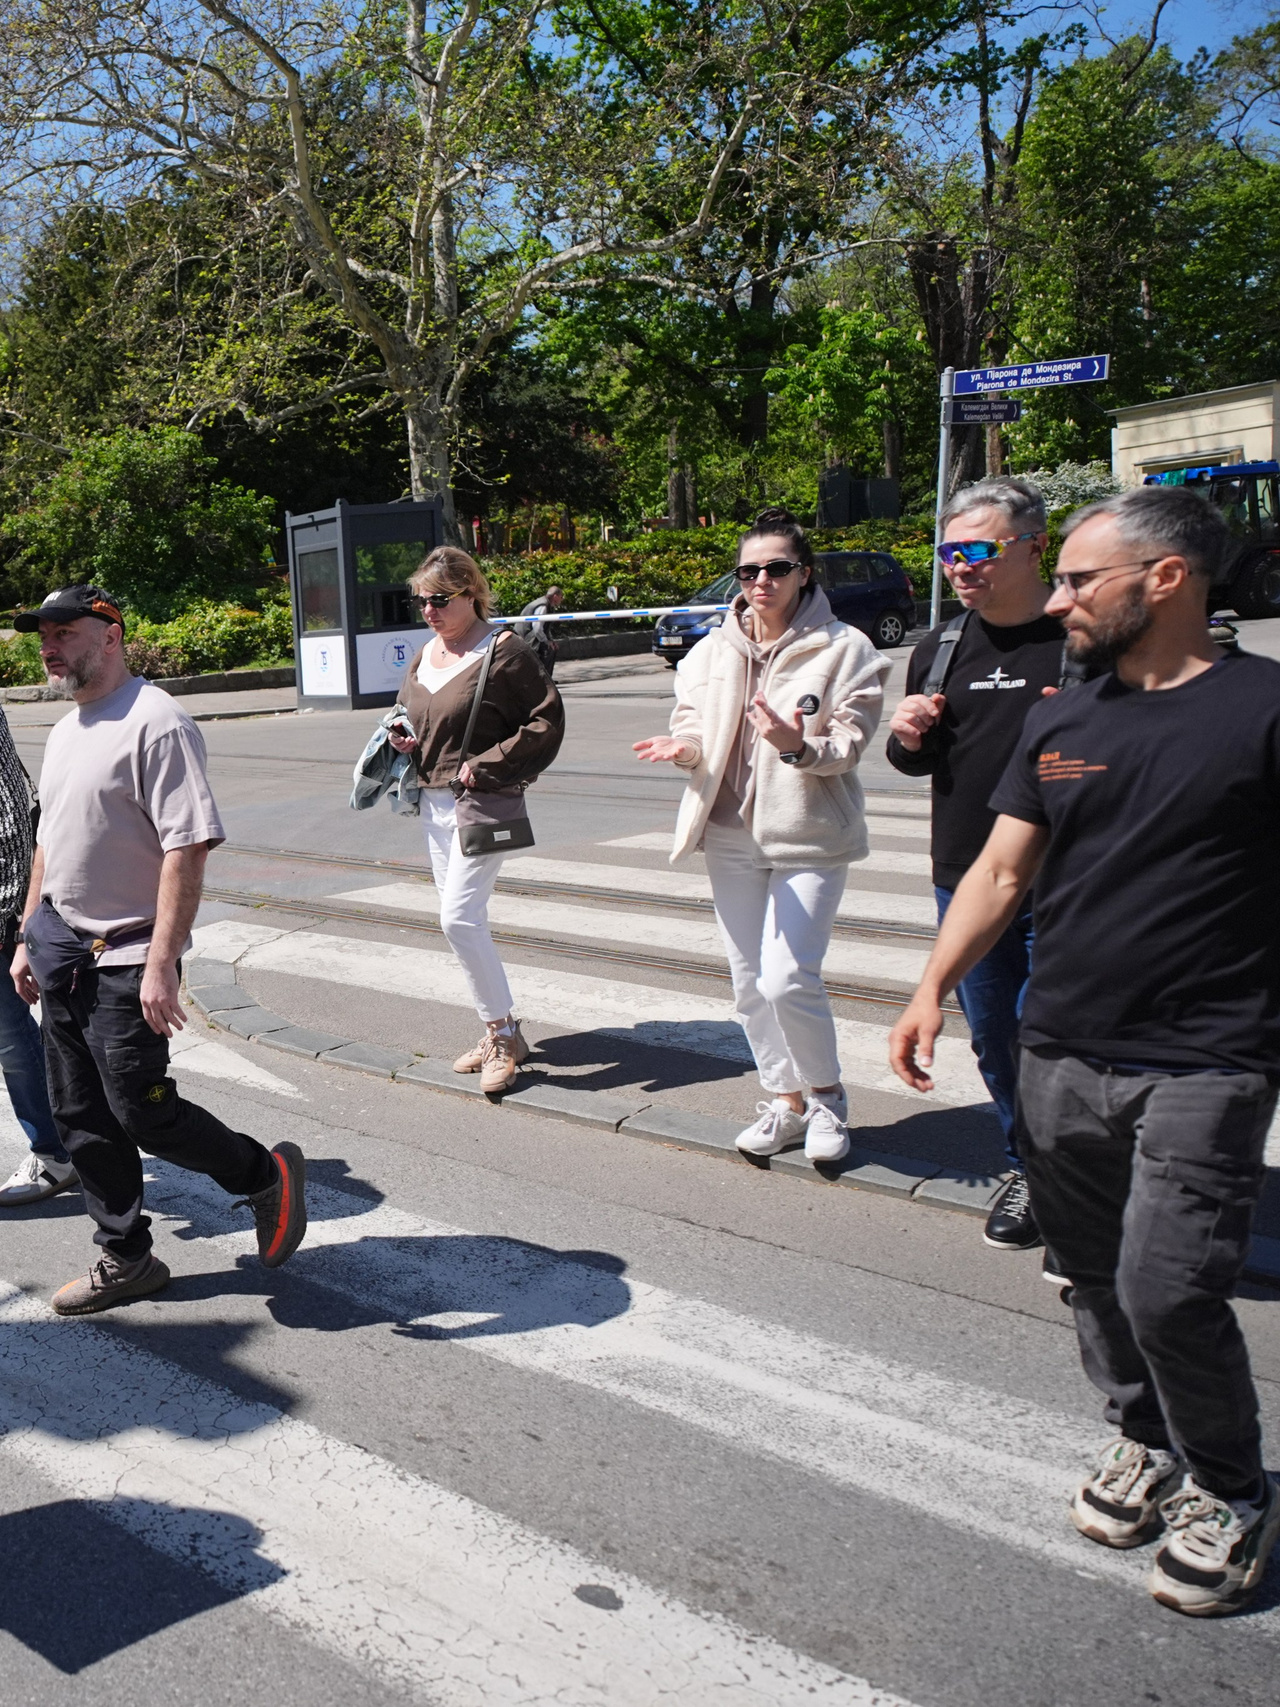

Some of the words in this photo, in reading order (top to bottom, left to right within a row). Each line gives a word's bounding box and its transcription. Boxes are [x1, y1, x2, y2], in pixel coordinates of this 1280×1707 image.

[971, 373, 983, 383] ул.
[987, 369, 1018, 380] Пјарона
[1022, 368, 1032, 378] де
[1036, 361, 1082, 374] Мондезира
[976, 381, 1005, 391] Pjarona
[1008, 379, 1017, 387] de
[1021, 375, 1060, 385] Mondezira
[1063, 373, 1074, 381] St.
[961, 403, 990, 413] Калемегдан
[990, 403, 1008, 411] Велики
[964, 412, 991, 422] Kalemegdan
[970, 681, 995, 690] STONE
[998, 679, 1026, 689] ISLAND
